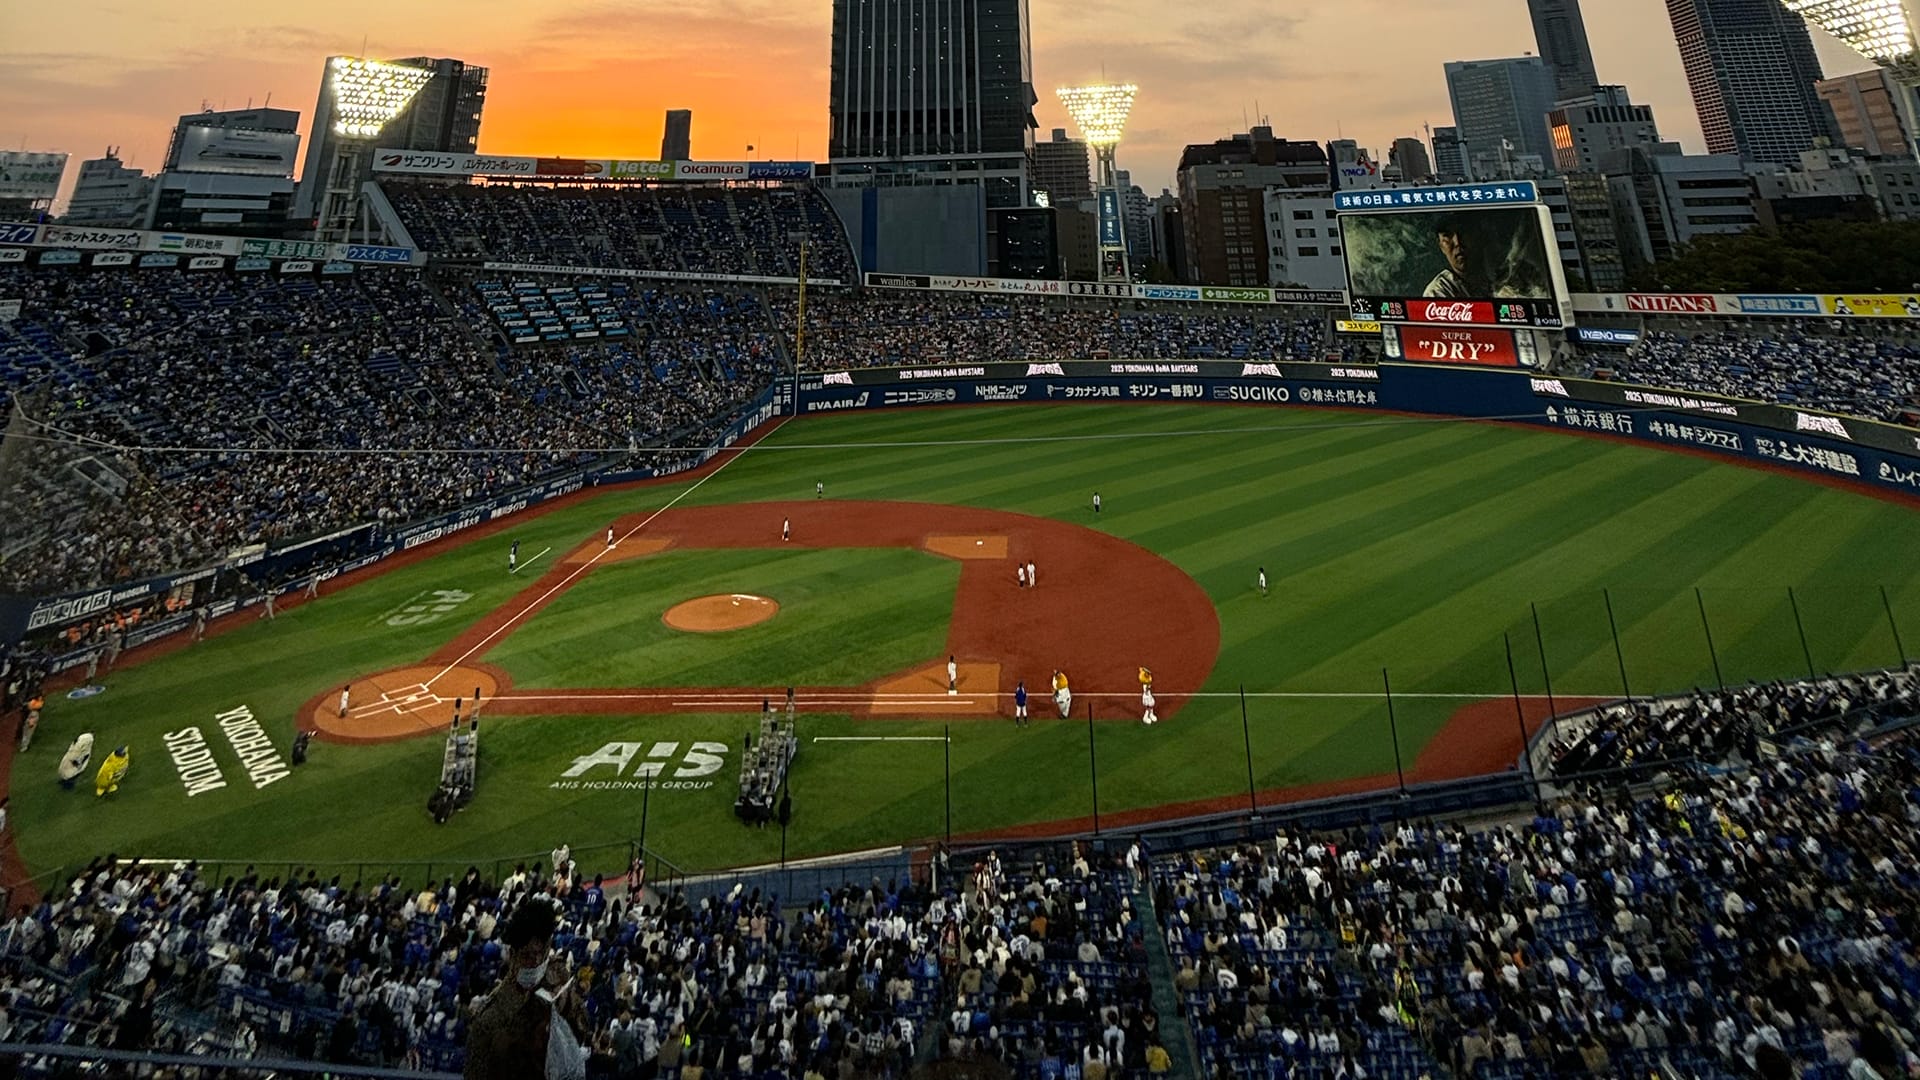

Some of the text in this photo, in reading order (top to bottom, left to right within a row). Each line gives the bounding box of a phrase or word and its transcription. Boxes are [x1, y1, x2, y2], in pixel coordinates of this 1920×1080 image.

[404, 155, 455, 169] サニクリーン
[1342, 168, 1367, 177] YMCA
[62, 231, 126, 244] ホットスタッフ
[185, 238, 223, 250] 明和地所
[349, 248, 408, 261] ウスイホーム
[880, 275, 917, 288] wamiles
[1628, 295, 1698, 312] NITTAN
[1441, 331, 1472, 341] SUPER
[1229, 386, 1289, 402] SUGIKO
[1312, 387, 1378, 405] 横浜信用金庫
[1564, 406, 1633, 434] 横浜銀行
[1793, 443, 1861, 477] 大洋建設
[214, 704, 291, 789] YOKOHAMA
[162, 726, 227, 797] STADIUM
[550, 781, 714, 790] AHS HOLDINGS GROUP
